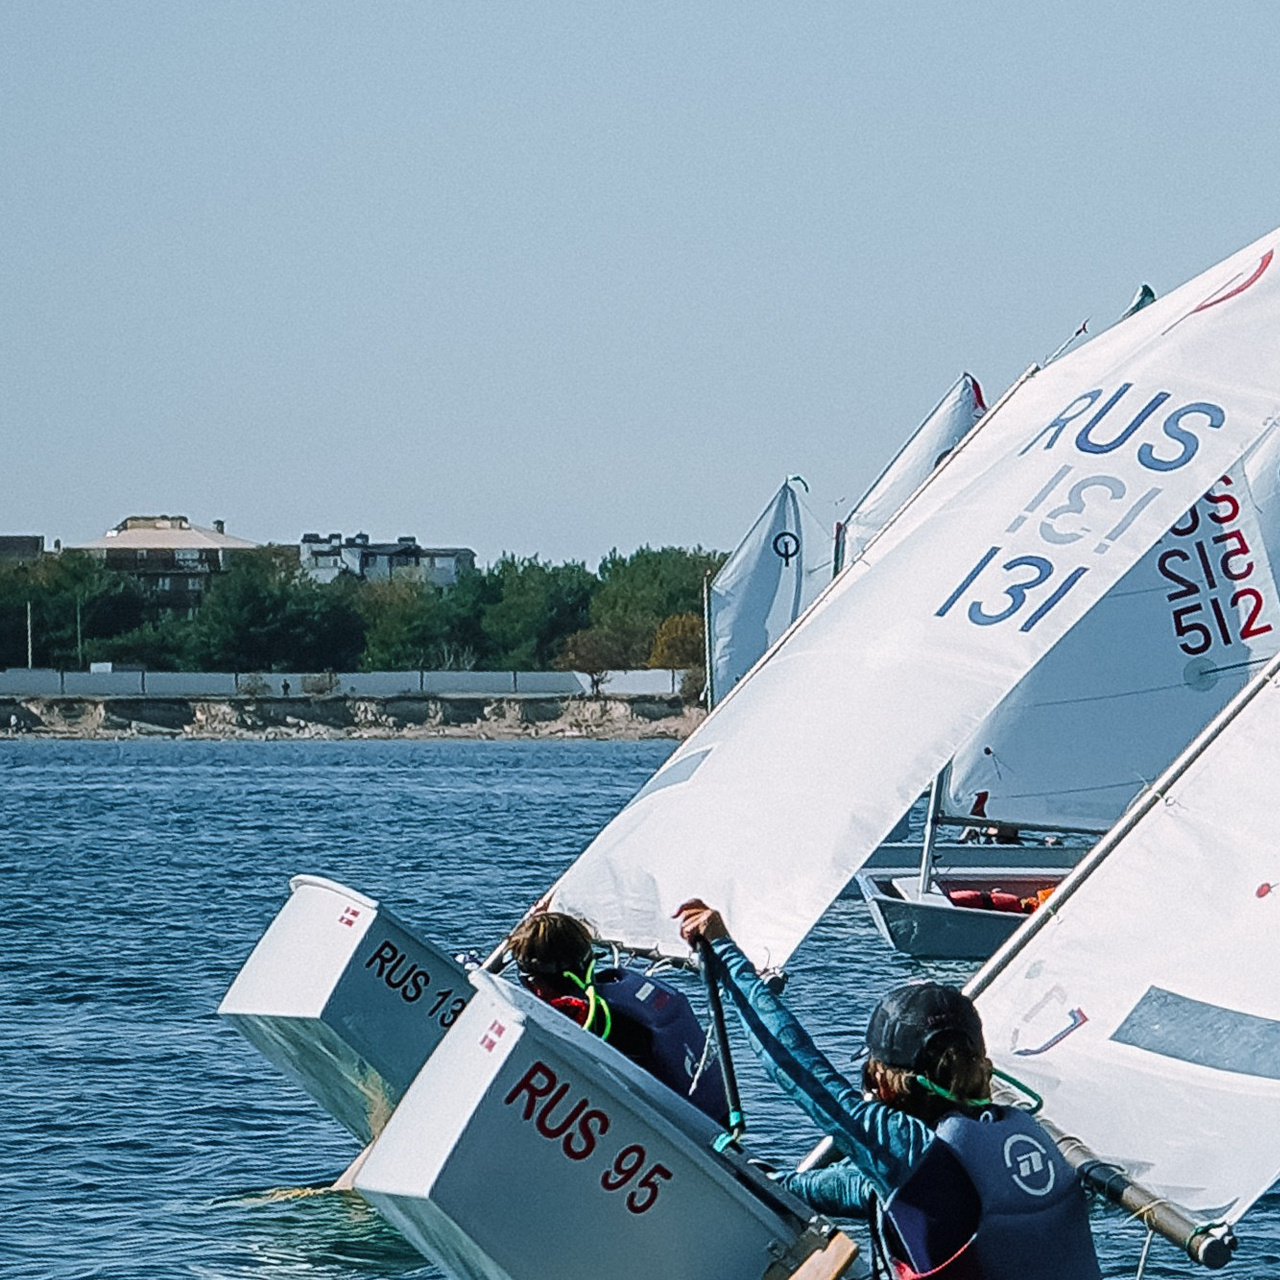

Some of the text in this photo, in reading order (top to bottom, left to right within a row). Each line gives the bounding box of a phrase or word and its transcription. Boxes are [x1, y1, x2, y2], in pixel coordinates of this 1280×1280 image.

[1019, 382, 1225, 473] RUS
[935, 547, 1089, 632] 131
[1172, 587, 1273, 656] 512
[365, 940, 467, 1028] RUS 13
[505, 1060, 674, 1215] RUS 95
